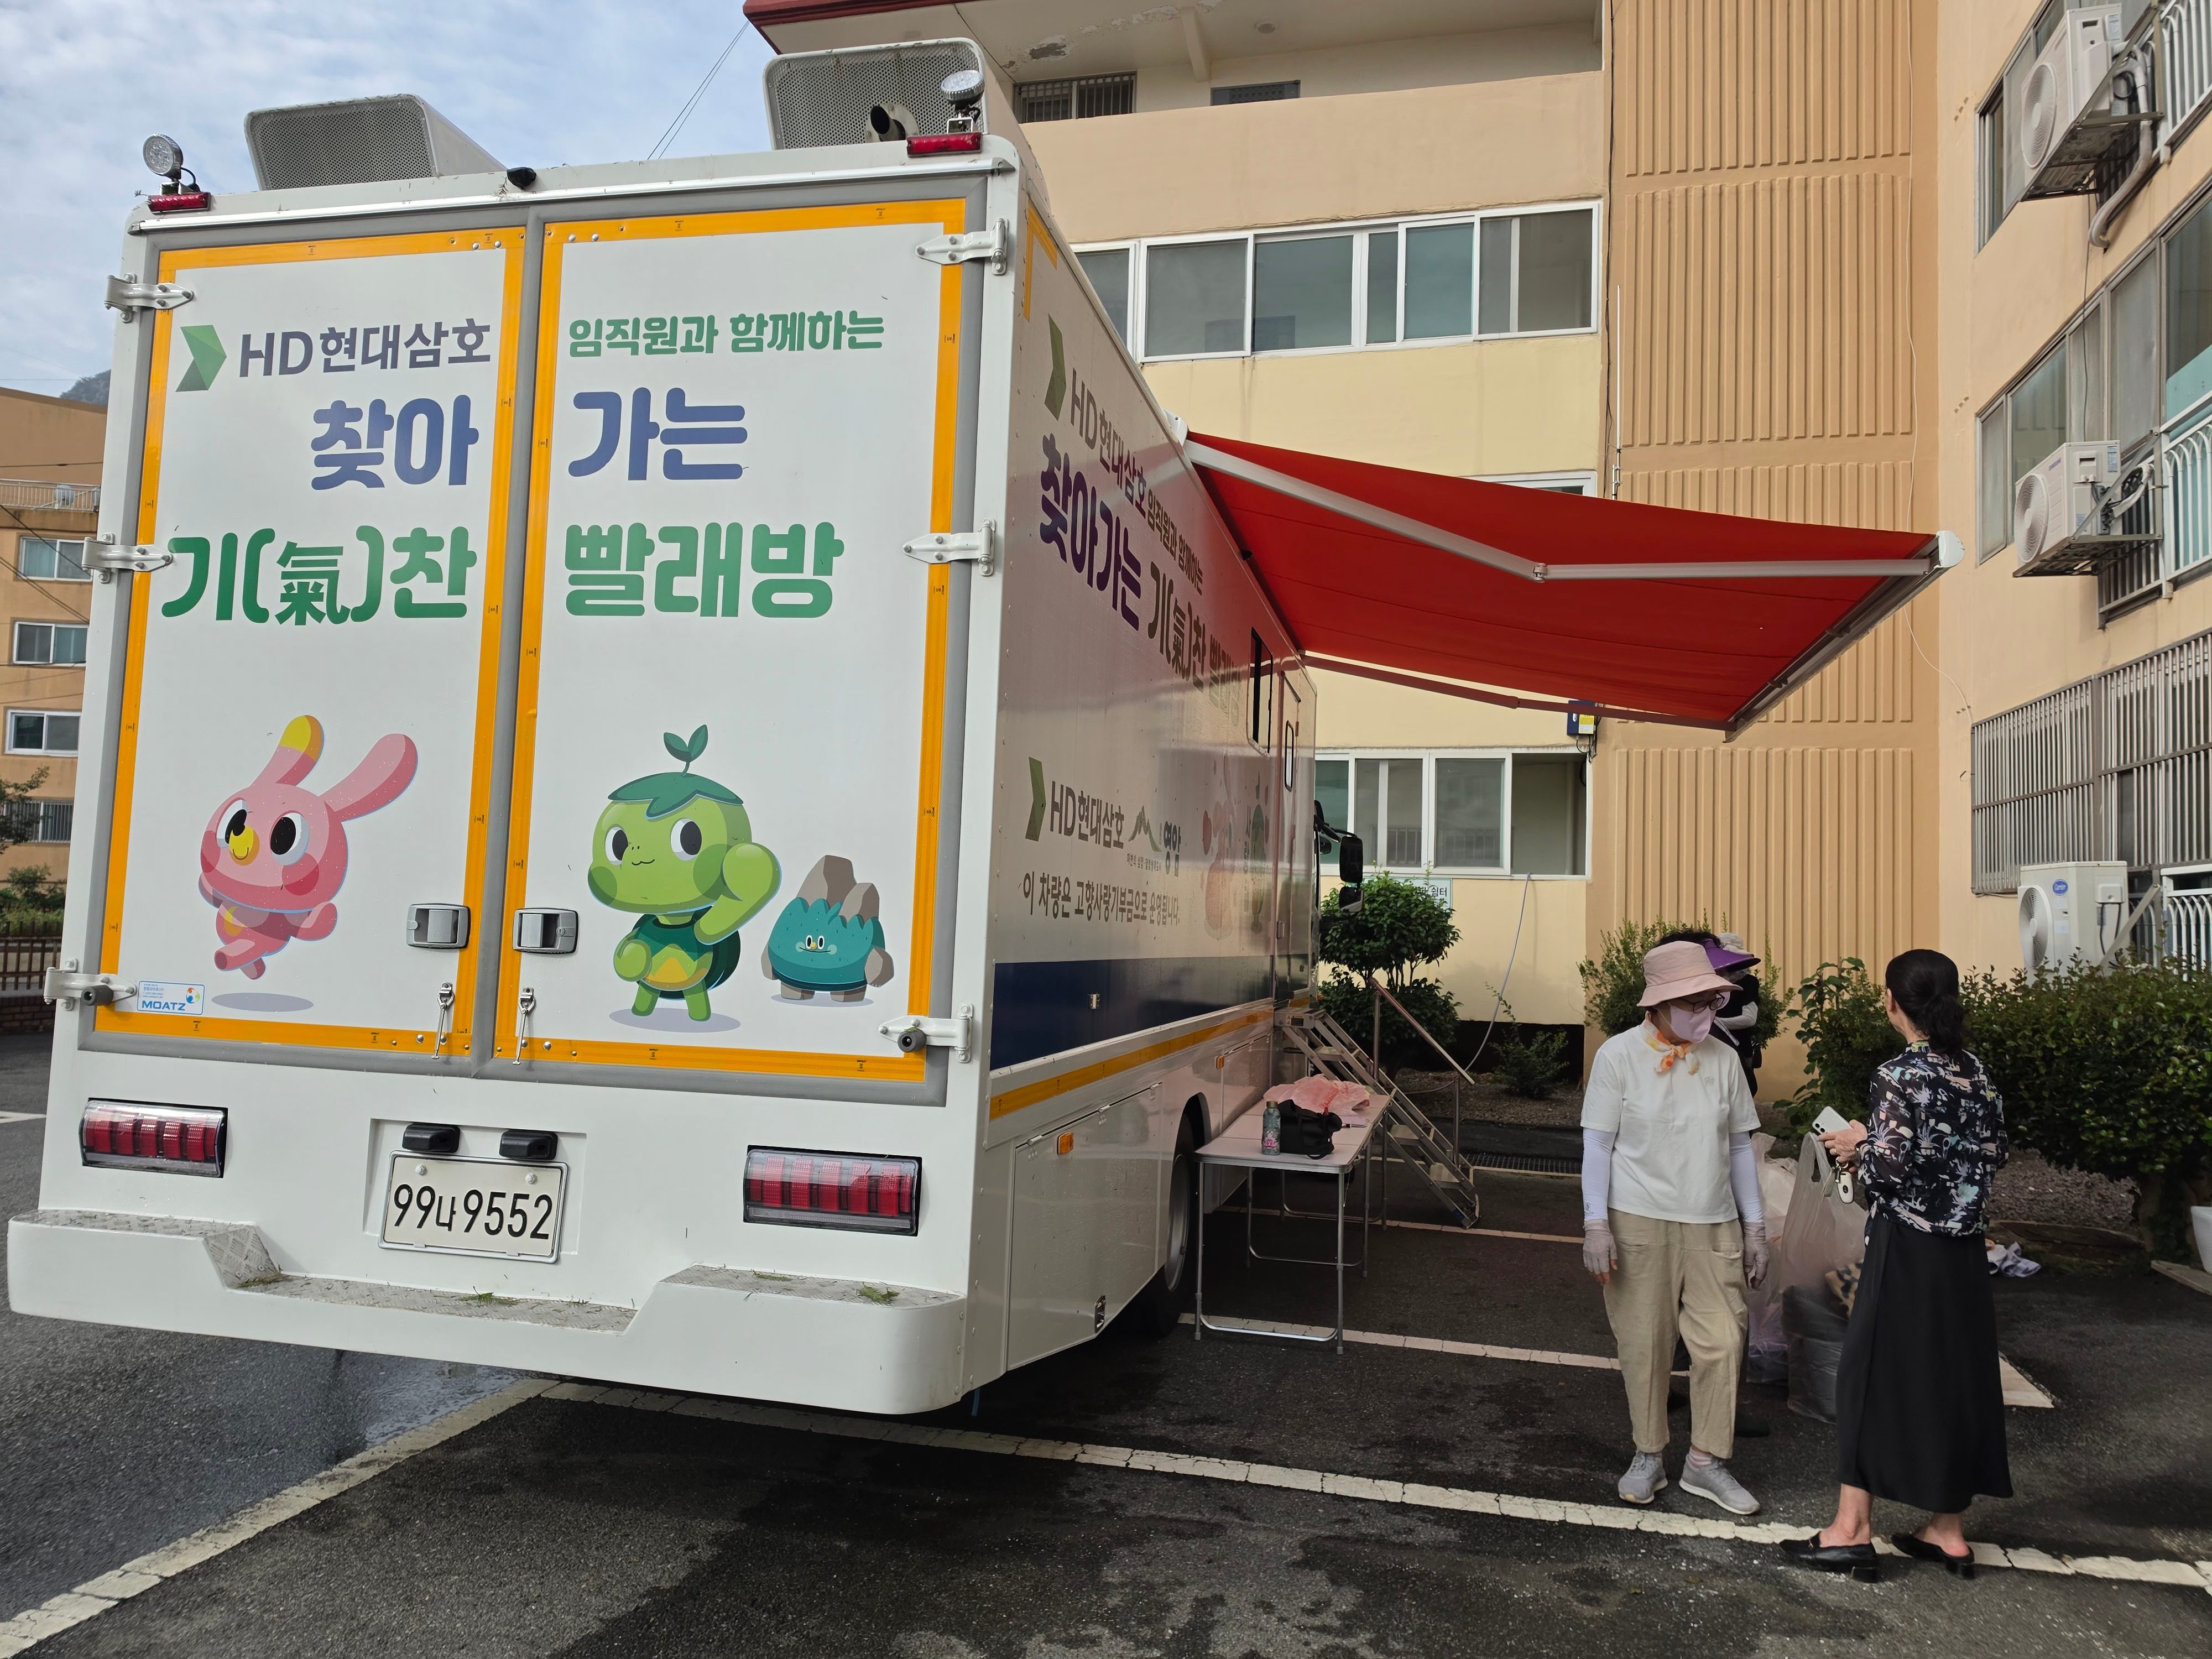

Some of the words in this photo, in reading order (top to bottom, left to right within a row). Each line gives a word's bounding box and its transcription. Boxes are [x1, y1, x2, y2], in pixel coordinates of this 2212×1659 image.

[239, 319, 491, 377] HD현대삼호
[569, 314, 718, 357] 임직원과
[729, 310, 884, 353] 함께하는
[311, 394, 479, 491] 찾아
[568, 387, 748, 481] 가는
[1071, 367, 1147, 519] HD현대삼호
[1148, 489, 1177, 562] 임직원과
[1178, 534, 1203, 596] 함께하는
[1040, 432, 1141, 632] 찾아가는
[565, 521, 844, 618] 빨래방
[1050, 780, 1125, 849] HD현대삼호
[1163, 821, 1182, 878] 영암
[1023, 871, 1035, 916] 이
[1038, 872, 1071, 919] 차량은
[1074, 880, 1147, 923] 고향사랑기부금으로
[1431, 886, 1447, 897] 쉼터
[142, 1000, 186, 1011] MOATZ
[394, 1183, 552, 1240] 99나9552
